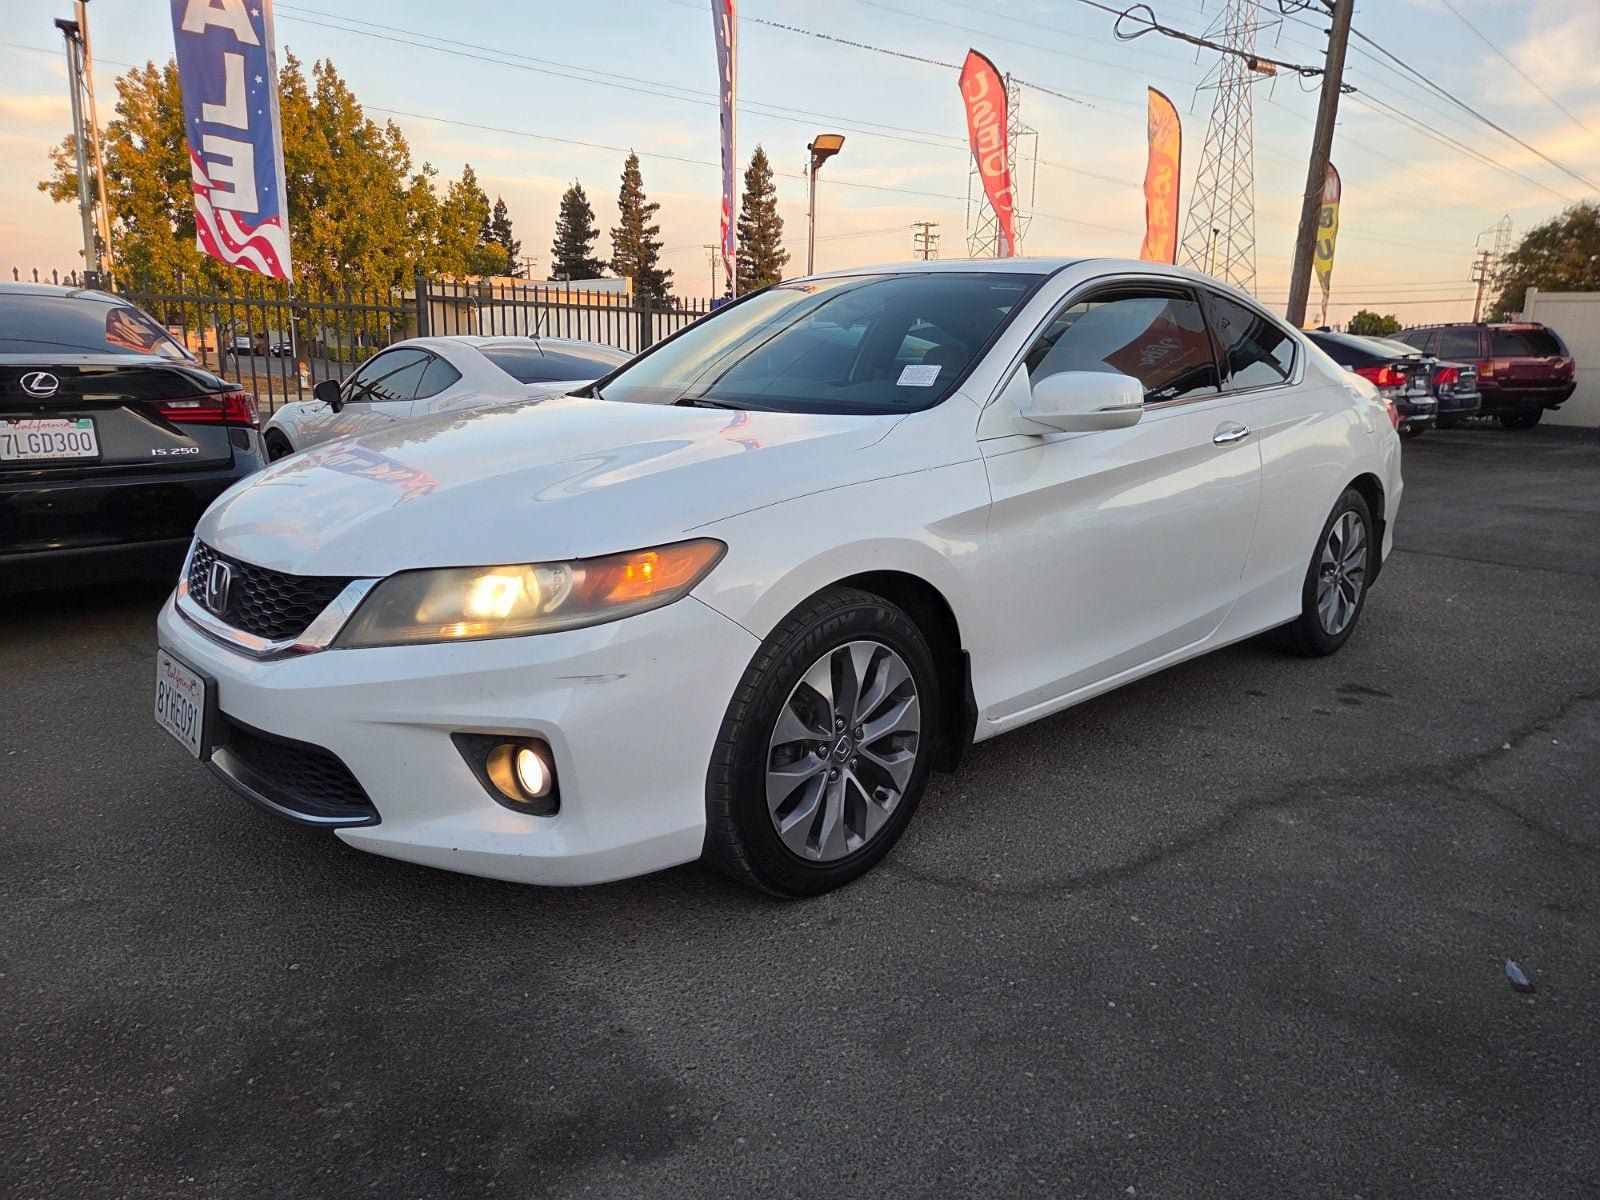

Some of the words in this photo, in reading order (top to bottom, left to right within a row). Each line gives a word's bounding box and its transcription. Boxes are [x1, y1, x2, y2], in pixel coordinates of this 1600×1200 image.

[0, 432, 93, 456] 7LGD300
[152, 448, 167, 457] IS
[168, 446, 199, 456] 250
[157, 680, 198, 745] 8YHE091
